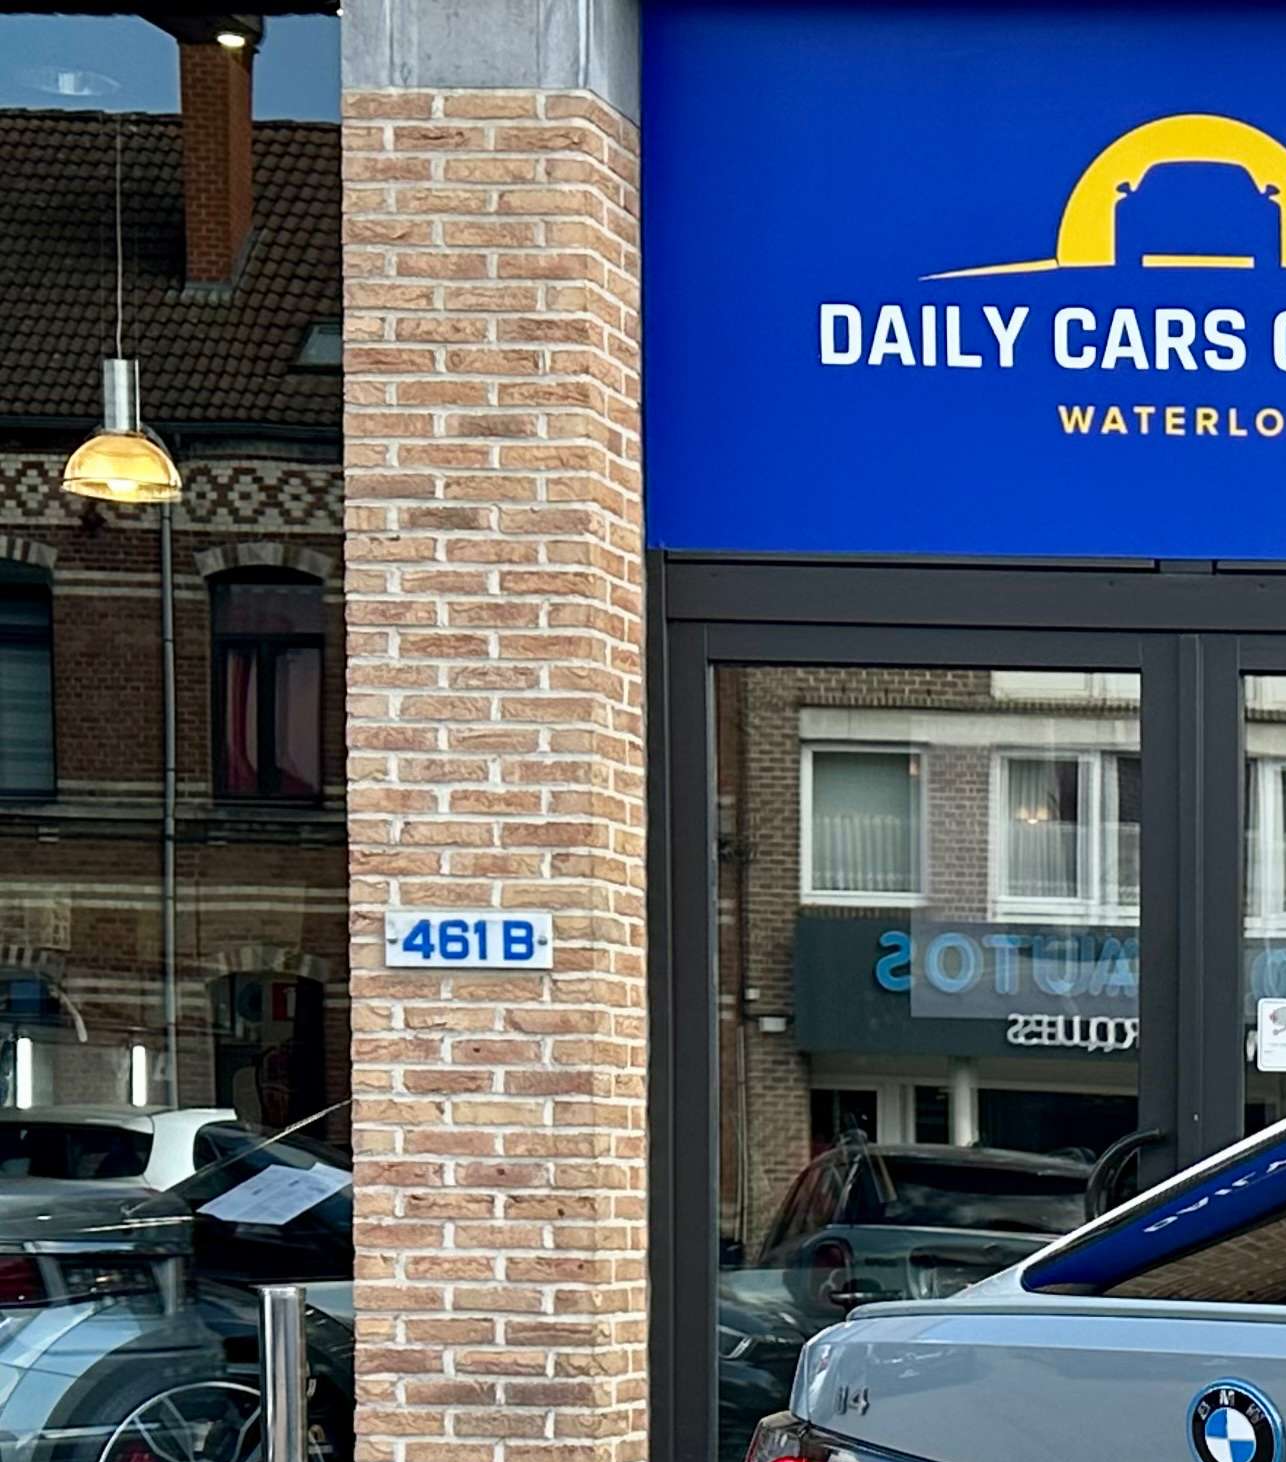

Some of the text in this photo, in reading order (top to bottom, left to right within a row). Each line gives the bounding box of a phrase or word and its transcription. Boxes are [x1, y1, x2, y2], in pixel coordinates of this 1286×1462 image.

[820, 303, 1030, 368] DAILY
[1054, 306, 1247, 372] CARS
[402, 919, 534, 961] 461 B
[1197, 1389, 1265, 1424] BMW
